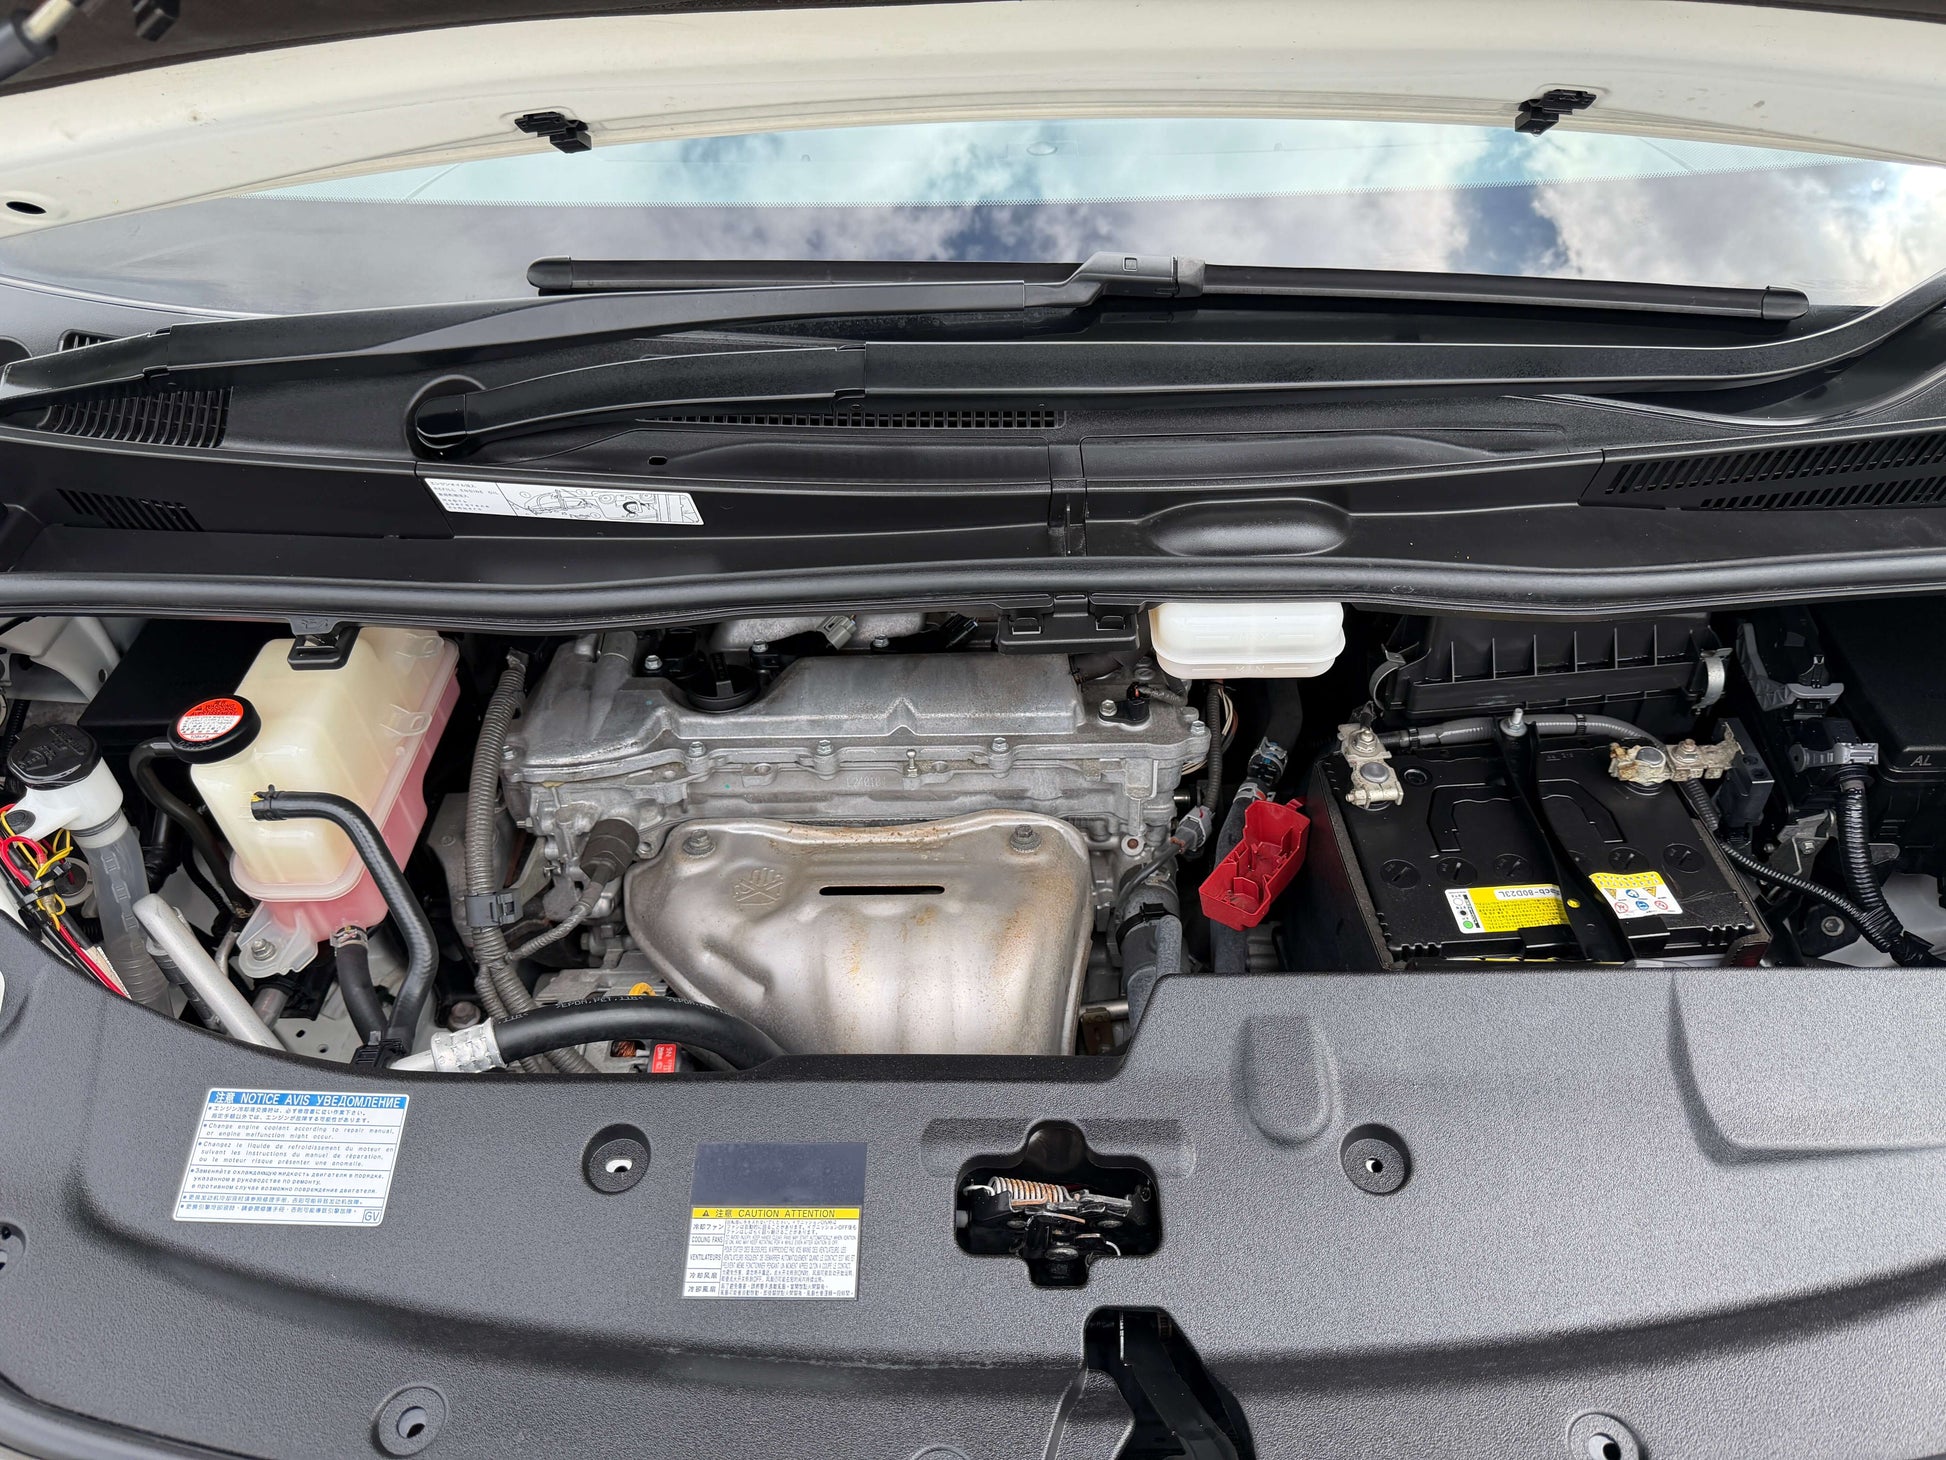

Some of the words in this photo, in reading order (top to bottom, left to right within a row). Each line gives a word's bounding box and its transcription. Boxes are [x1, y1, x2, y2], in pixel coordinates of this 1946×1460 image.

[214, 1092, 235, 1103] 注意
[240, 1093, 280, 1104] NOTICE
[285, 1094, 310, 1105] AVIS
[316, 1096, 401, 1108] УВЕДОМЛЕНИЕ
[365, 1211, 380, 1221] GV
